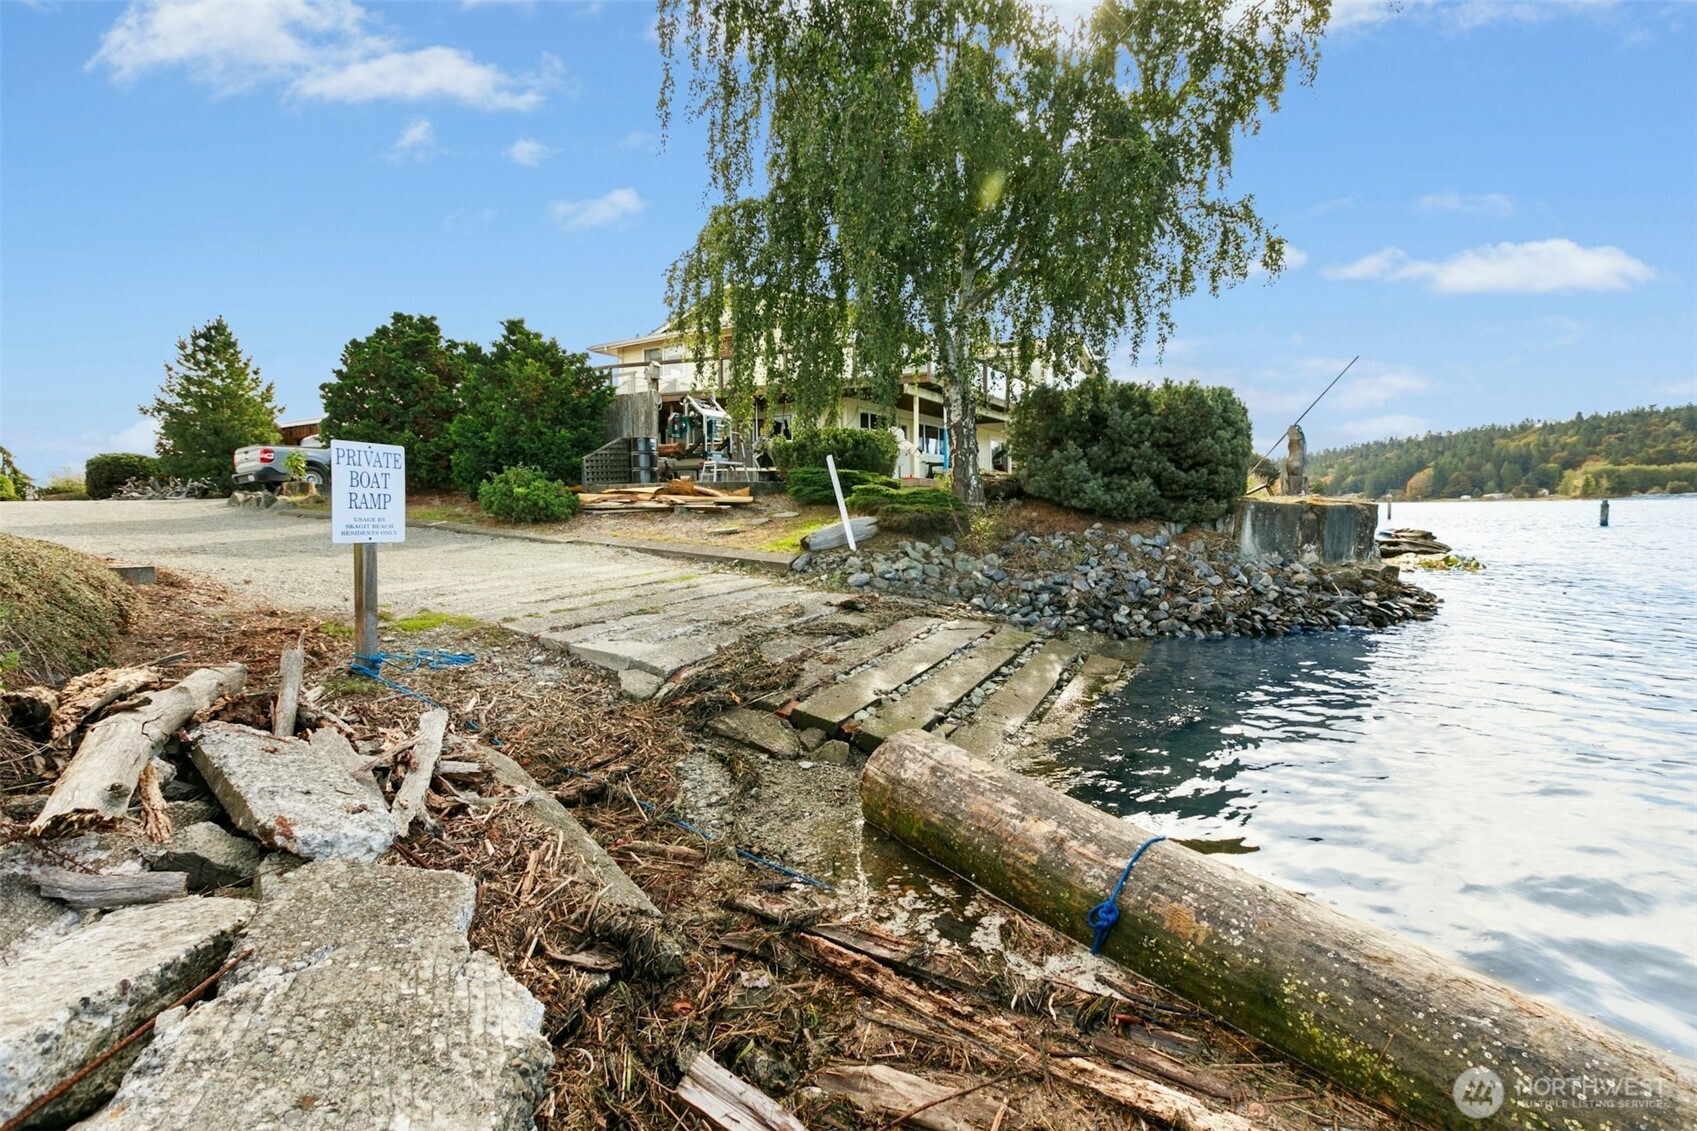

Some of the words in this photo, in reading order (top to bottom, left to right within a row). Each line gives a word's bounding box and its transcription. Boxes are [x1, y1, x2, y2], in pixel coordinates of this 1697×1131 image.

[335, 448, 402, 469] PRIVATE
[349, 470, 391, 489] BOAT
[348, 492, 392, 510] RAMP
